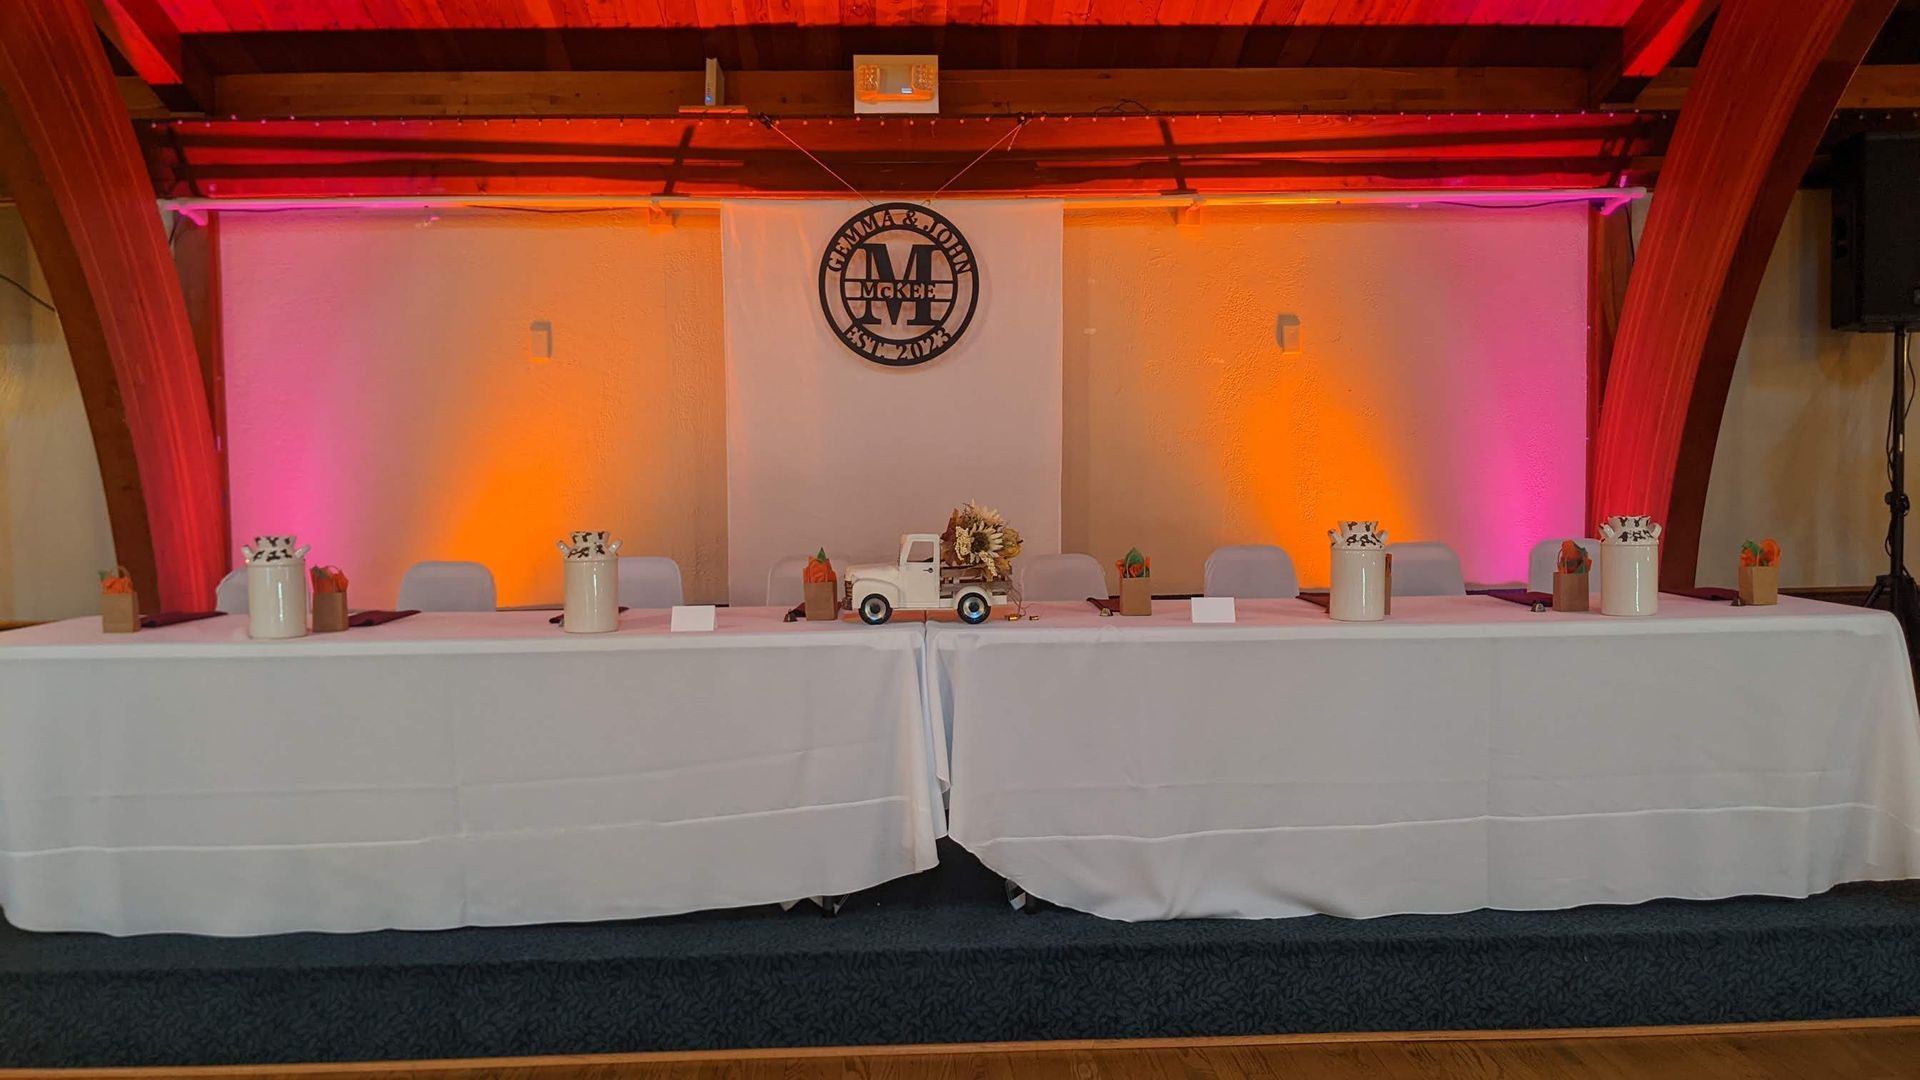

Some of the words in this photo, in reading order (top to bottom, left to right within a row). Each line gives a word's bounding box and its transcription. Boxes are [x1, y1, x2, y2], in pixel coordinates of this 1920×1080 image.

[827, 210, 895, 273] GEMMA
[903, 211, 918, 226] &
[923, 217, 973, 275] JOHN
[856, 244, 941, 325] M
[897, 327, 952, 360] 2023
